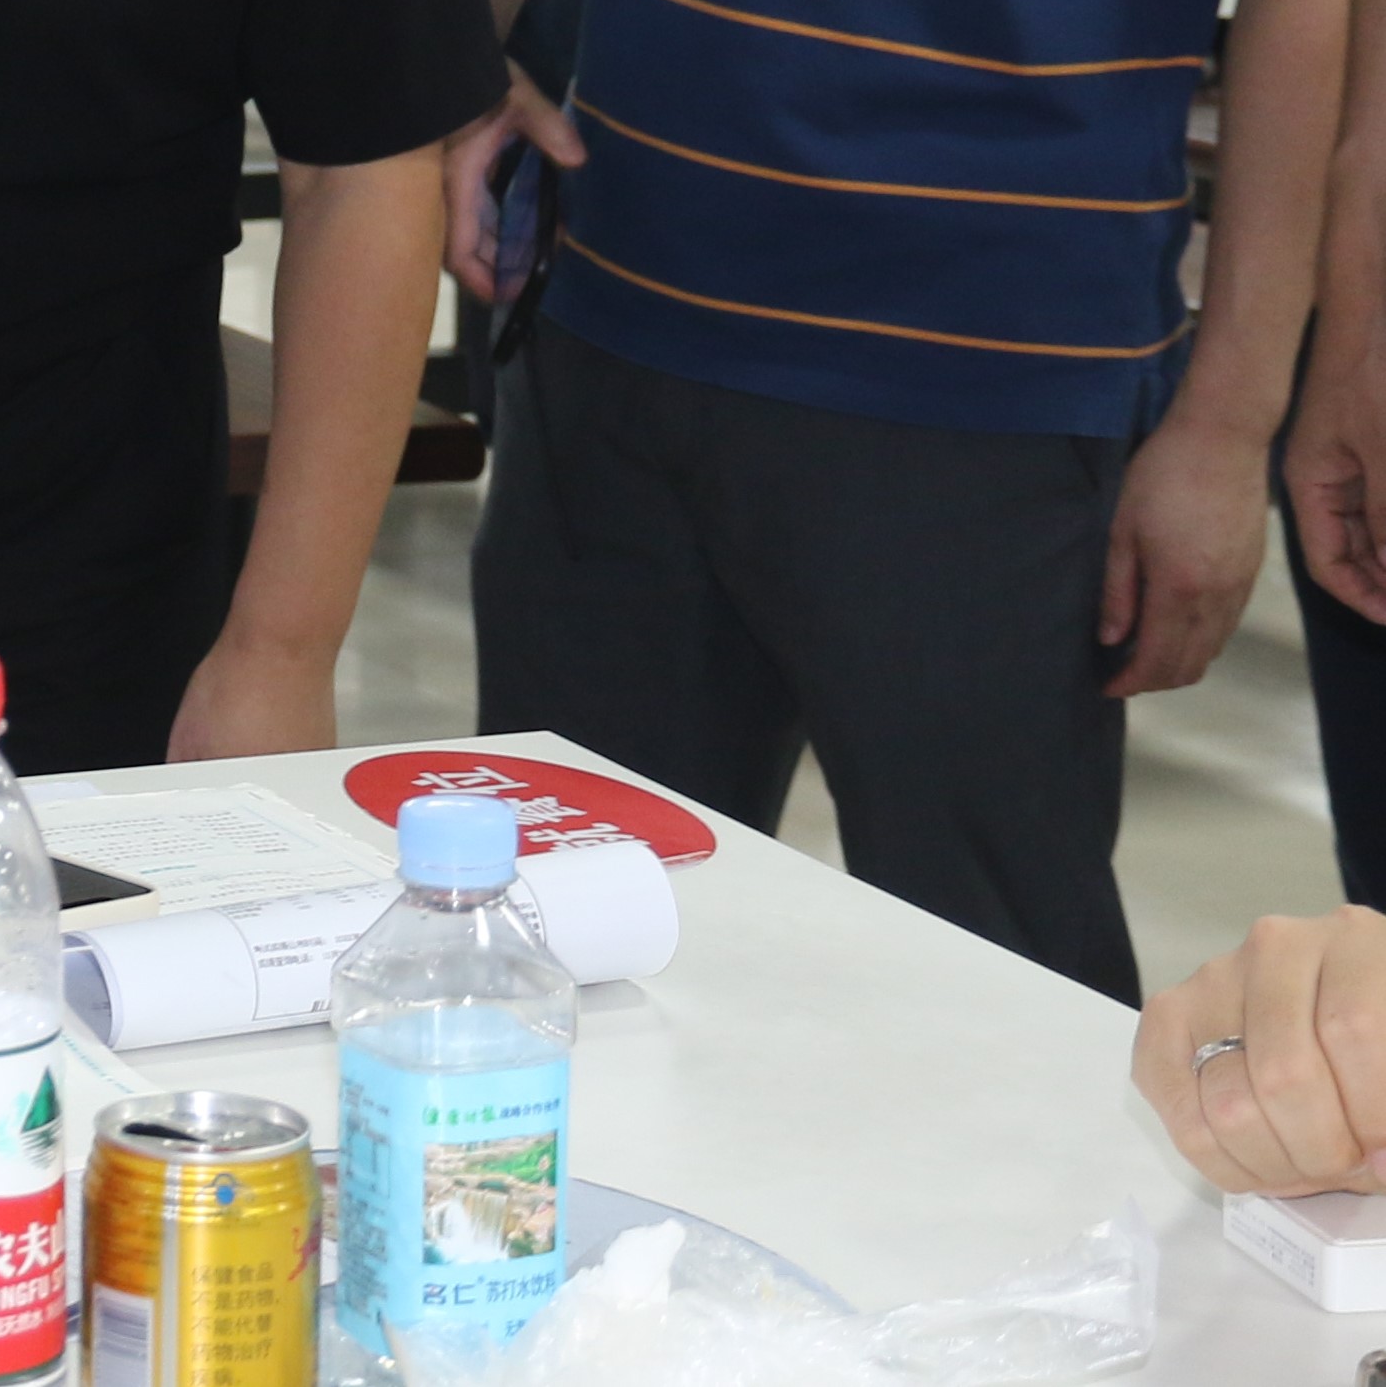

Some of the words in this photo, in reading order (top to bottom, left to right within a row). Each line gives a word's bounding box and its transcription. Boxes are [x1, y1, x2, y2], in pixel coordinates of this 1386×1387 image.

[192, 1261, 274, 1285] 保健食品
[423, 1282, 476, 1304] 名仁
[192, 1313, 273, 1336] 不能代替
[192, 1337, 274, 1362] 药物治疗
